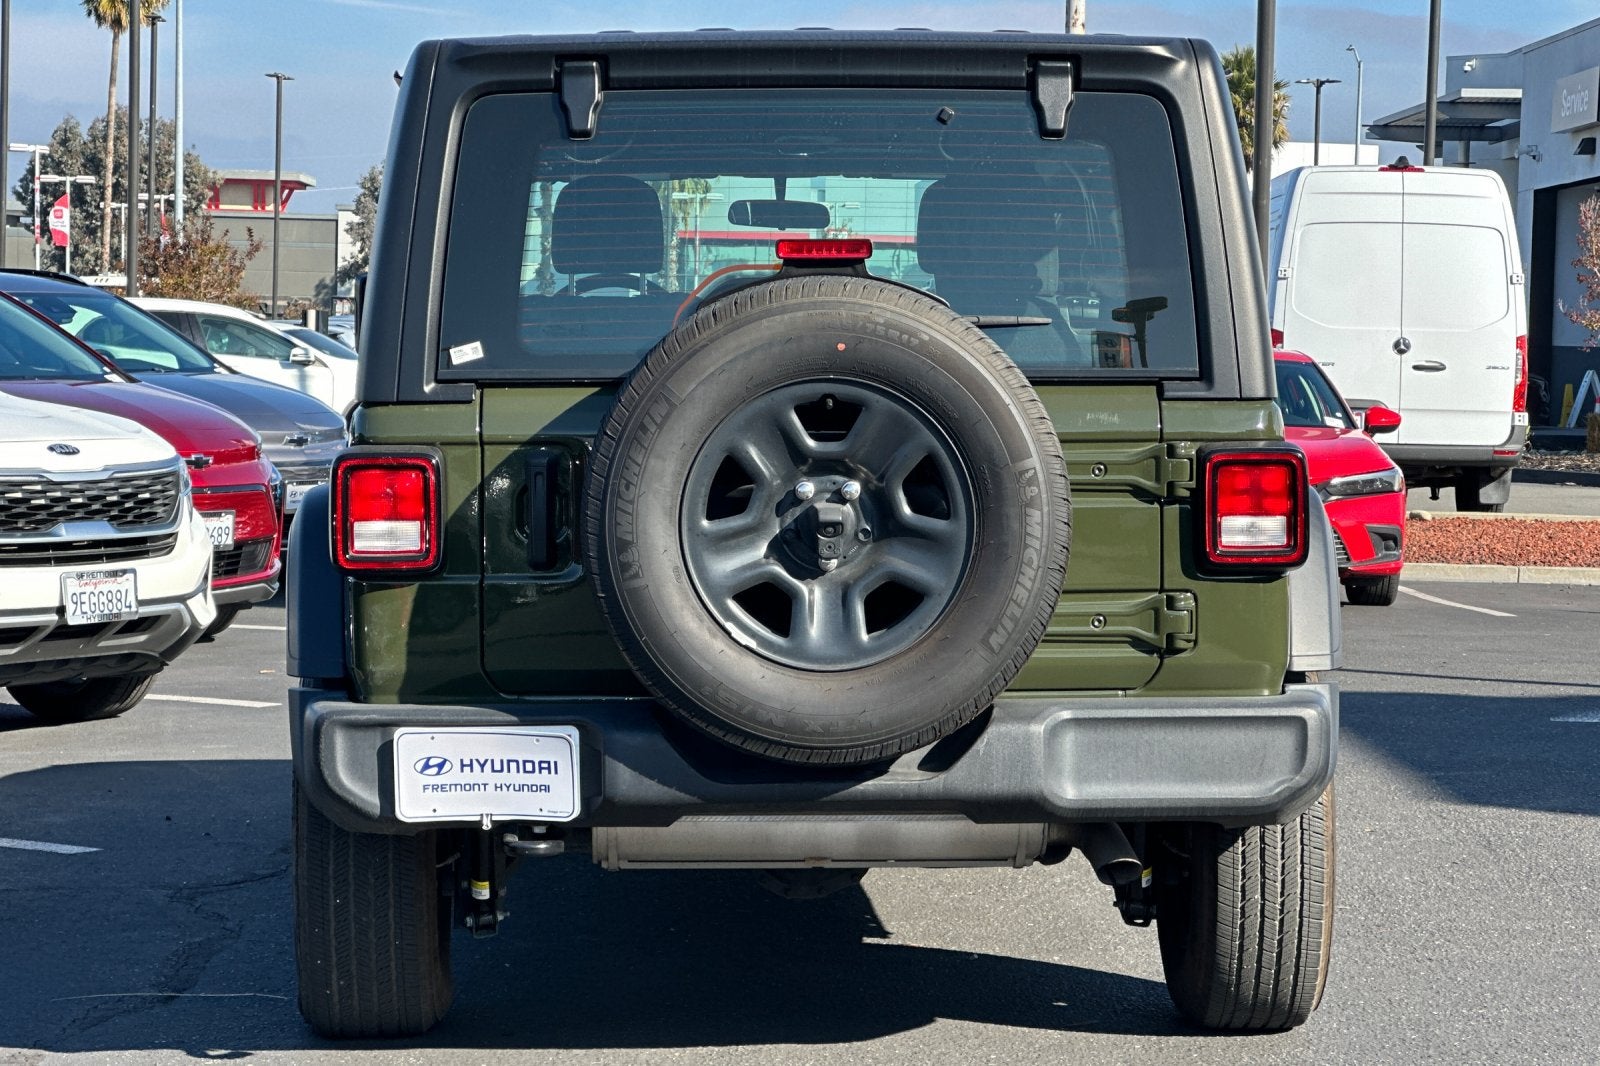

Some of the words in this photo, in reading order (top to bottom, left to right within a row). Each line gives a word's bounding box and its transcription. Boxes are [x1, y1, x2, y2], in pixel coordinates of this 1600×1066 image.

[1561, 84, 1589, 117] Service
[50, 443, 80, 455] KIA
[615, 391, 671, 542] MICHELIN
[989, 508, 1042, 654] MICHELIN
[71, 588, 132, 616] 9EGG884
[86, 612, 122, 622] HYUNDAI
[460, 758, 558, 775] HYUNDAI
[422, 783, 489, 793] FREMONT
[494, 783, 550, 793] HYUNDAI
